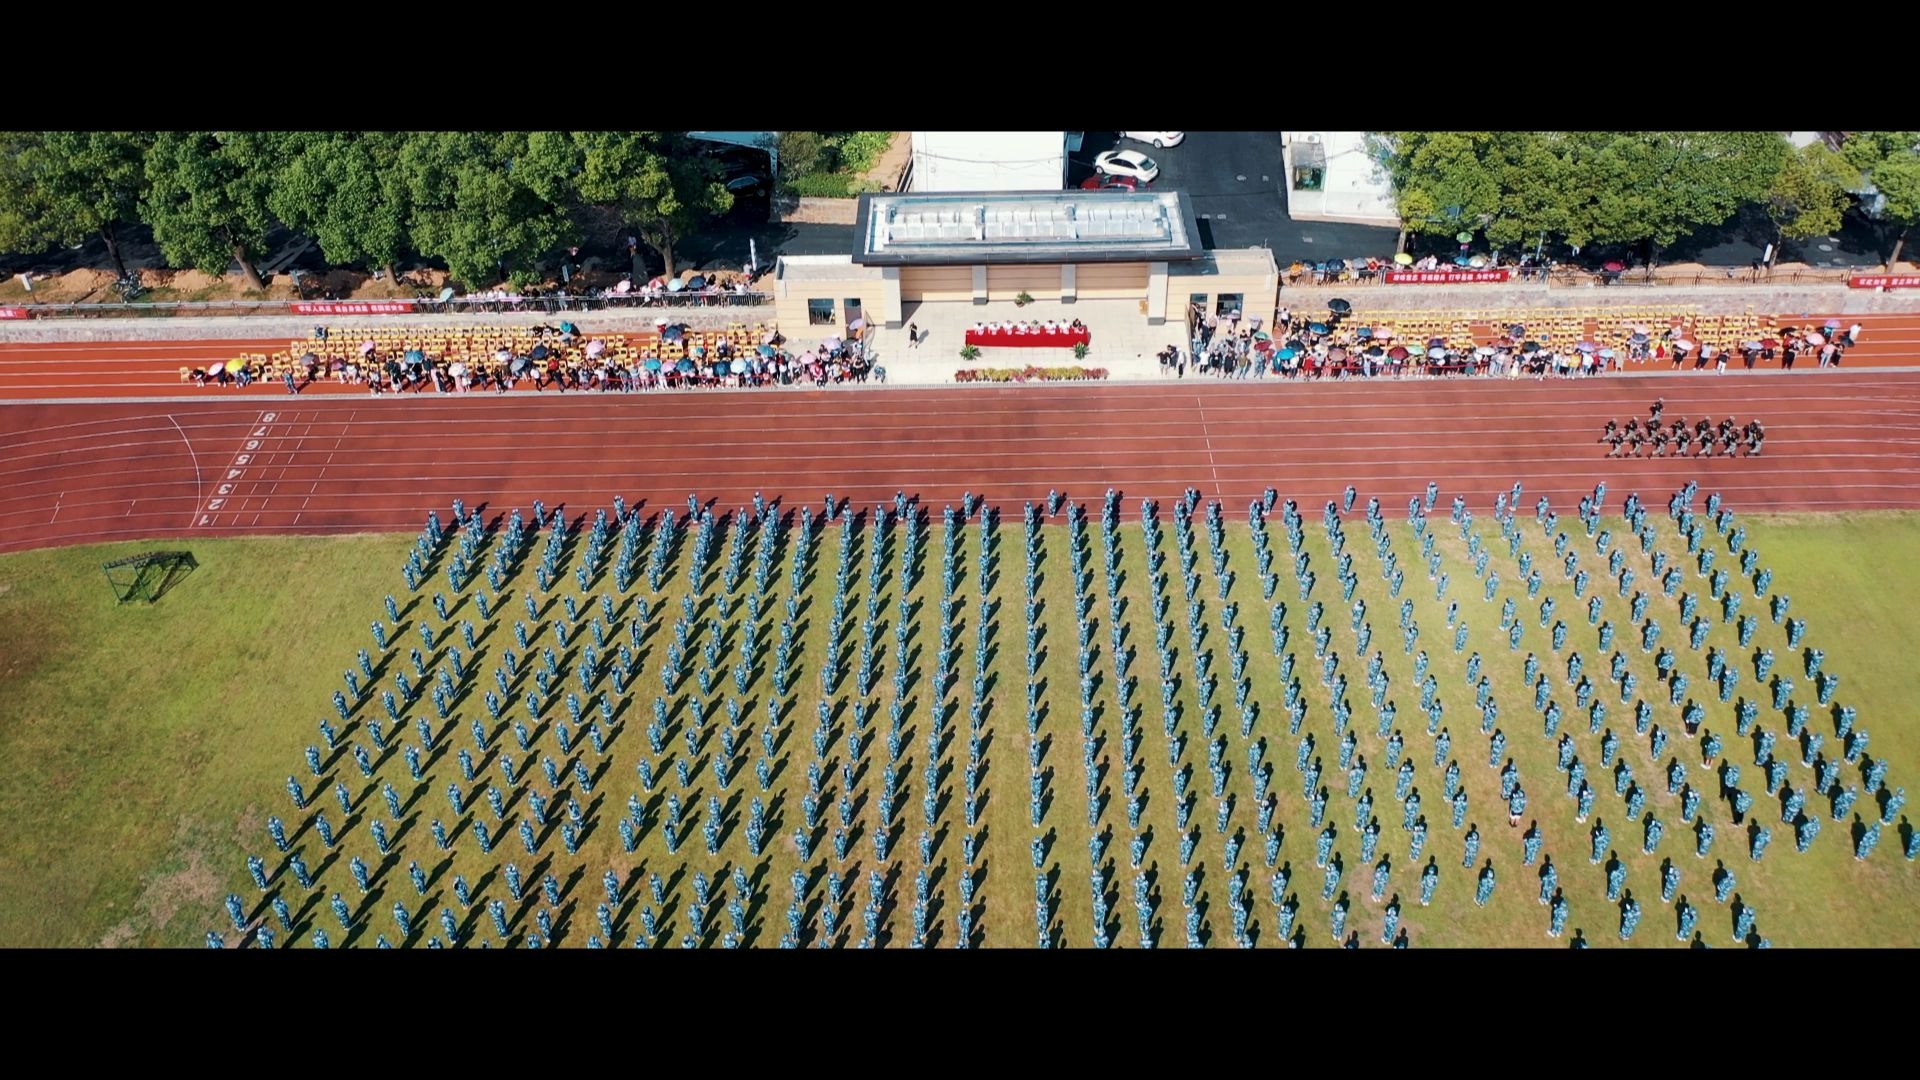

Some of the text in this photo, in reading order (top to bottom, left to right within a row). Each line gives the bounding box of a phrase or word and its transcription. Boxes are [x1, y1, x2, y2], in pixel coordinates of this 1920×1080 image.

[262, 412, 276, 423] 8
[253, 426, 267, 436] 7
[245, 440, 259, 450] 6
[235, 454, 250, 465] 5
[226, 468, 241, 479] 4
[218, 483, 232, 494] 3
[207, 498, 224, 510] 2
[198, 514, 209, 526] 1
